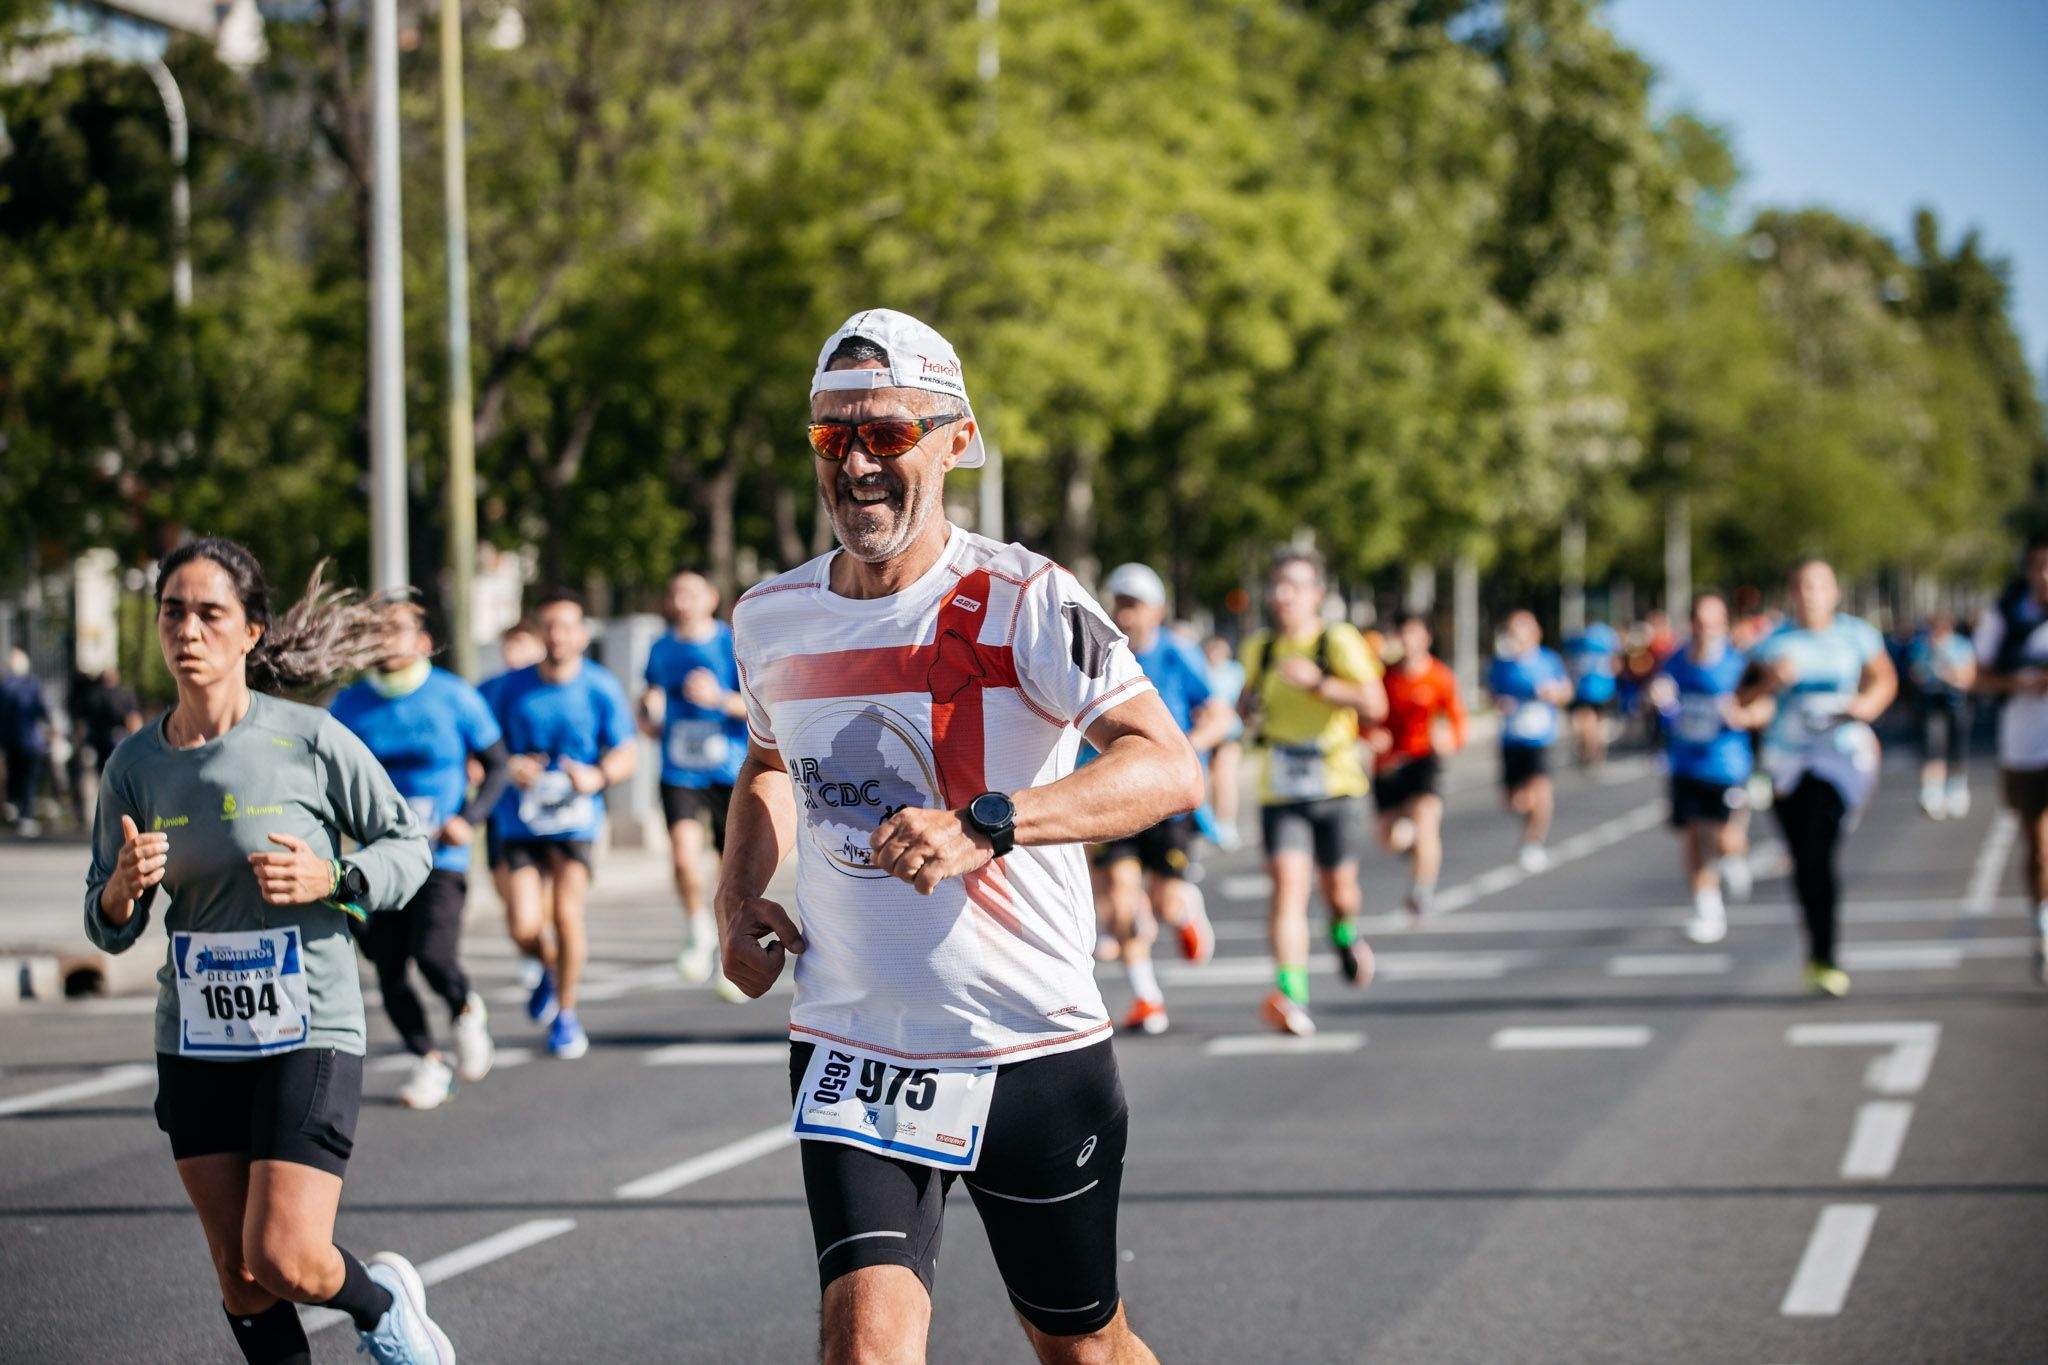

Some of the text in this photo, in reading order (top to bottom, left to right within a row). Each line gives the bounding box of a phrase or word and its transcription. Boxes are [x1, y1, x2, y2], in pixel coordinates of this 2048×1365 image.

[819, 780, 882, 807] CDC
[212, 949, 273, 961] BOMBEROS
[200, 983, 279, 1020] 1694
[813, 1050, 856, 1105] 2650
